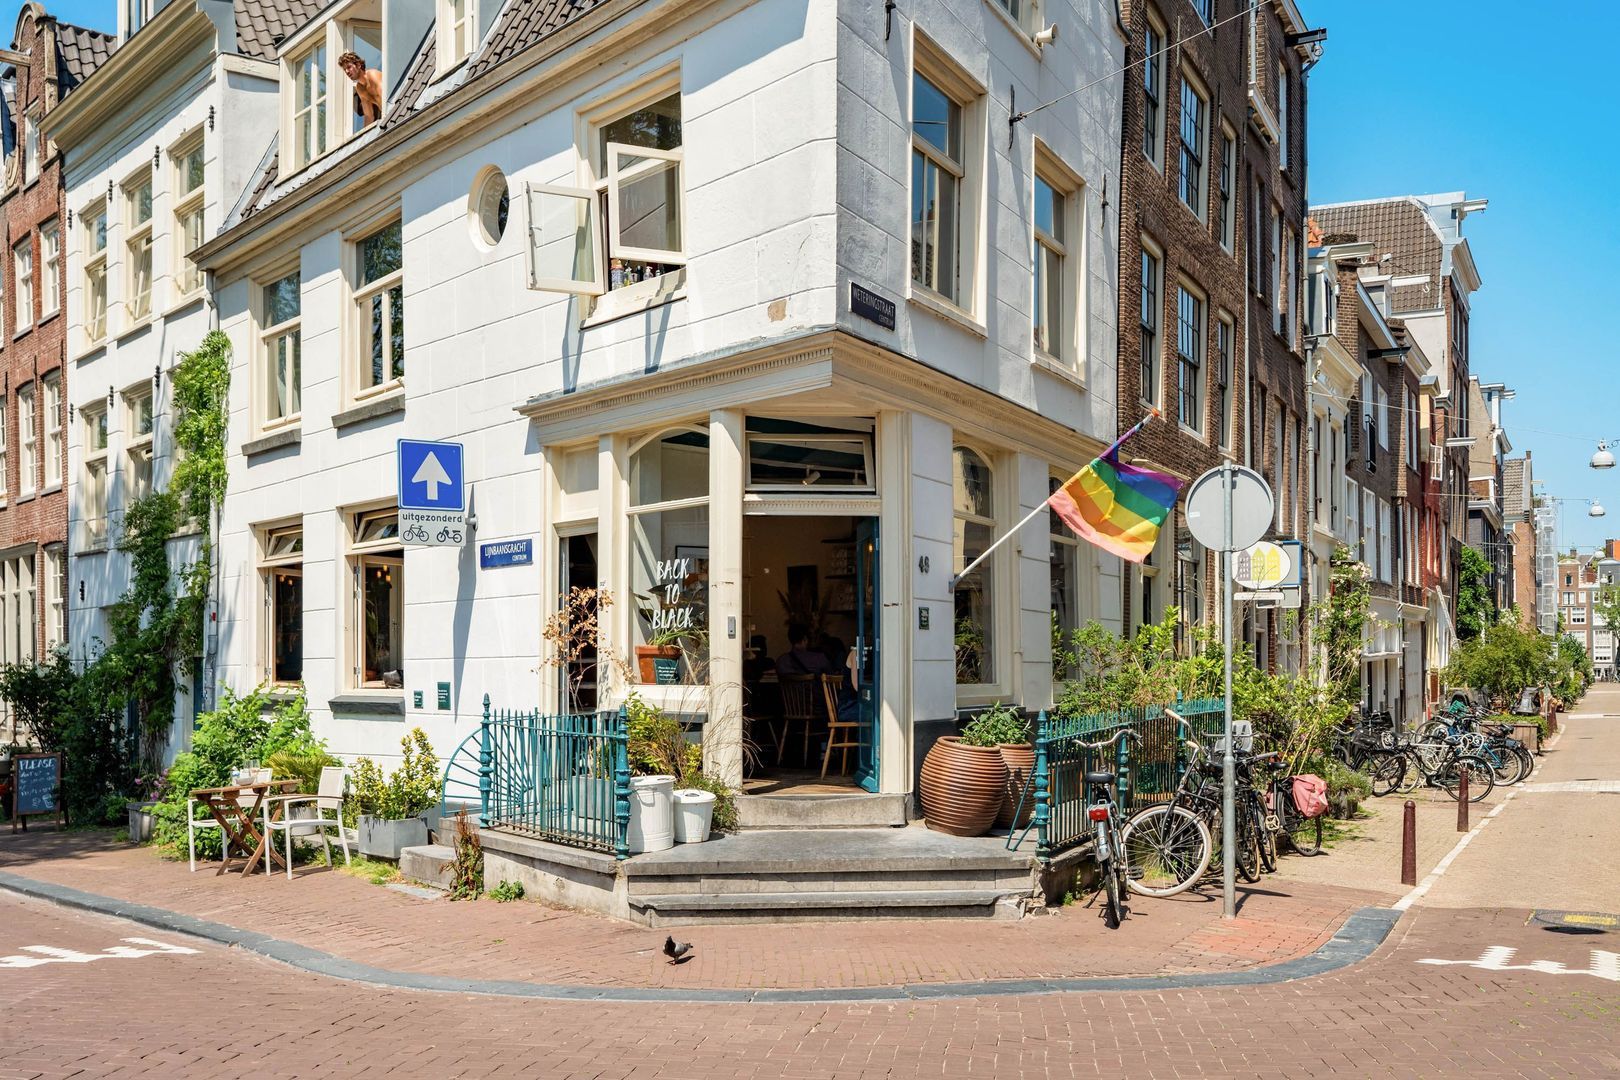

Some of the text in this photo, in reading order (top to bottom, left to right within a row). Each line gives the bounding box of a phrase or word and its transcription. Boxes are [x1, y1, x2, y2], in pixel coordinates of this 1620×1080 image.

[402, 512, 462, 523] uitgezonderd
[656, 557, 690, 580] BACK
[664, 583, 681, 605] TO
[652, 607, 693, 630] BLACK
[19, 758, 55, 771] PLEASE
